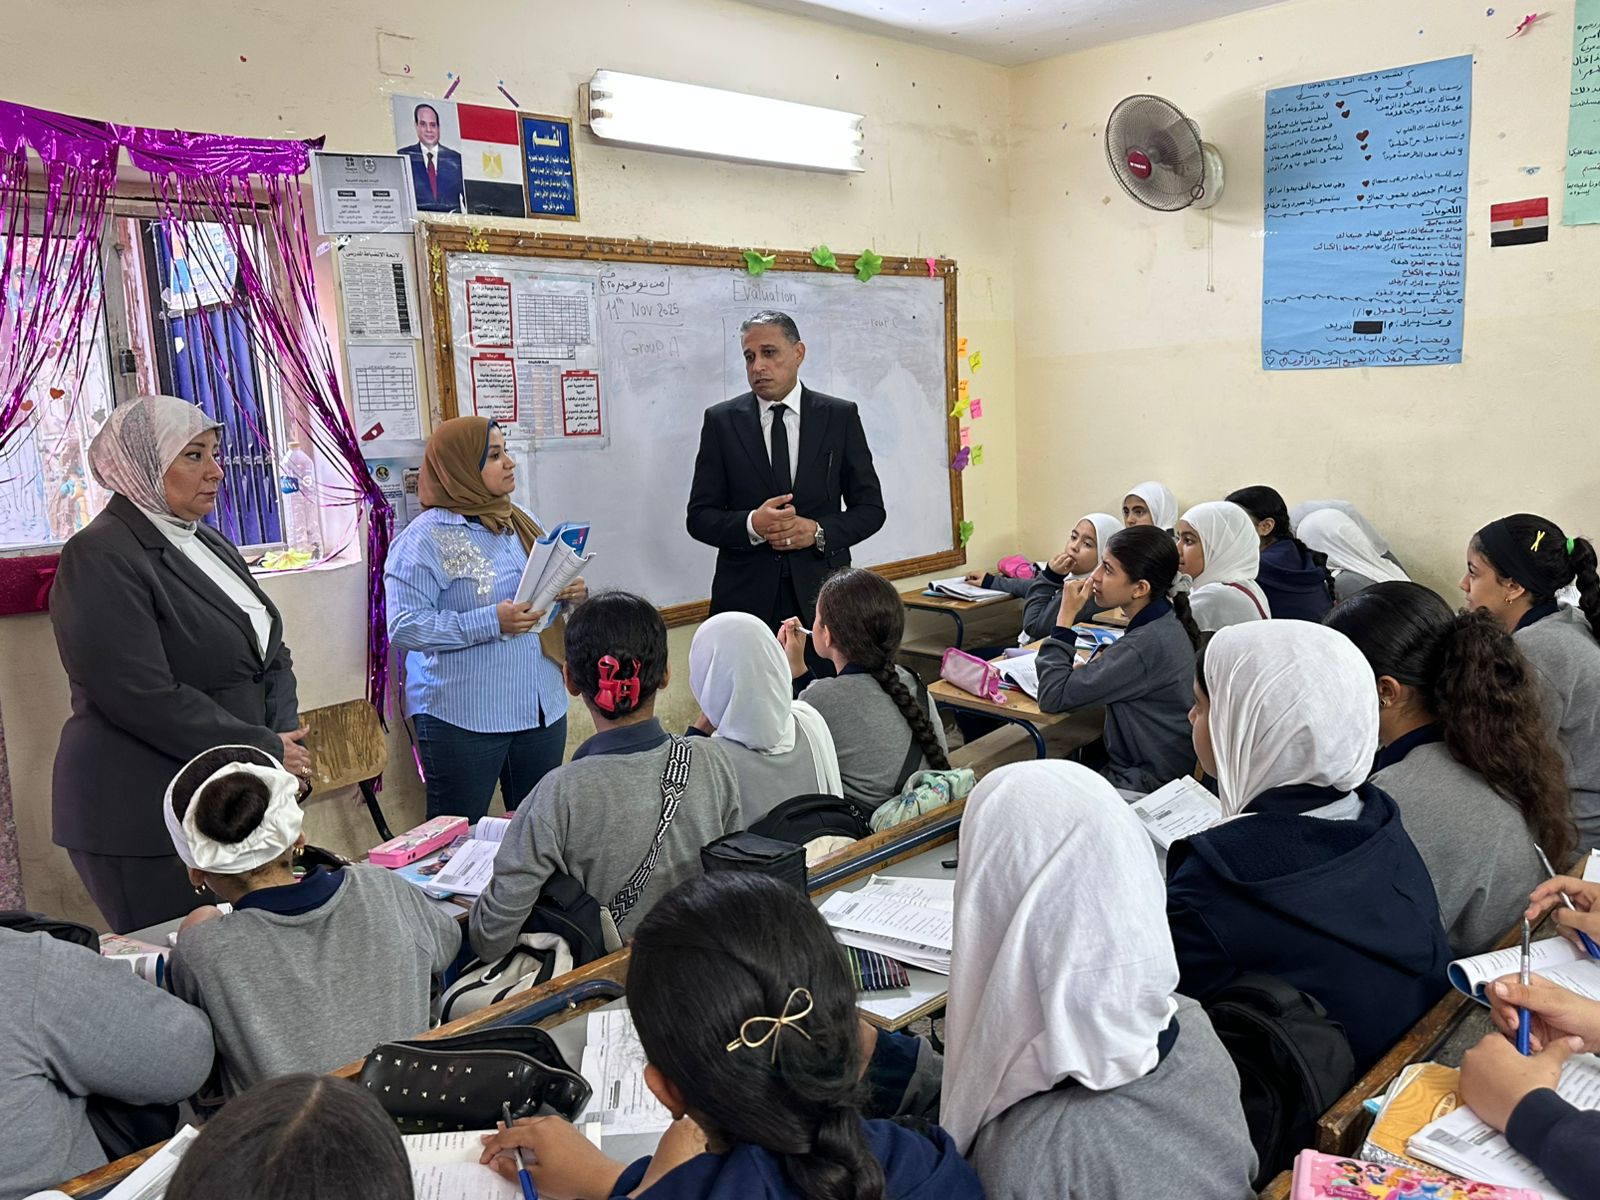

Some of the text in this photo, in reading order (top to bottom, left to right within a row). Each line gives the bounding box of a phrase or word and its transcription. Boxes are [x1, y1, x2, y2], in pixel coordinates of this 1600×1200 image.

[532, 125, 562, 150] القسم
[616, 280, 648, 292] نوفمبر
[732, 280, 796, 304] Evaluation
[657, 302, 679, 317] 2025
[620, 330, 680, 359] Group A
